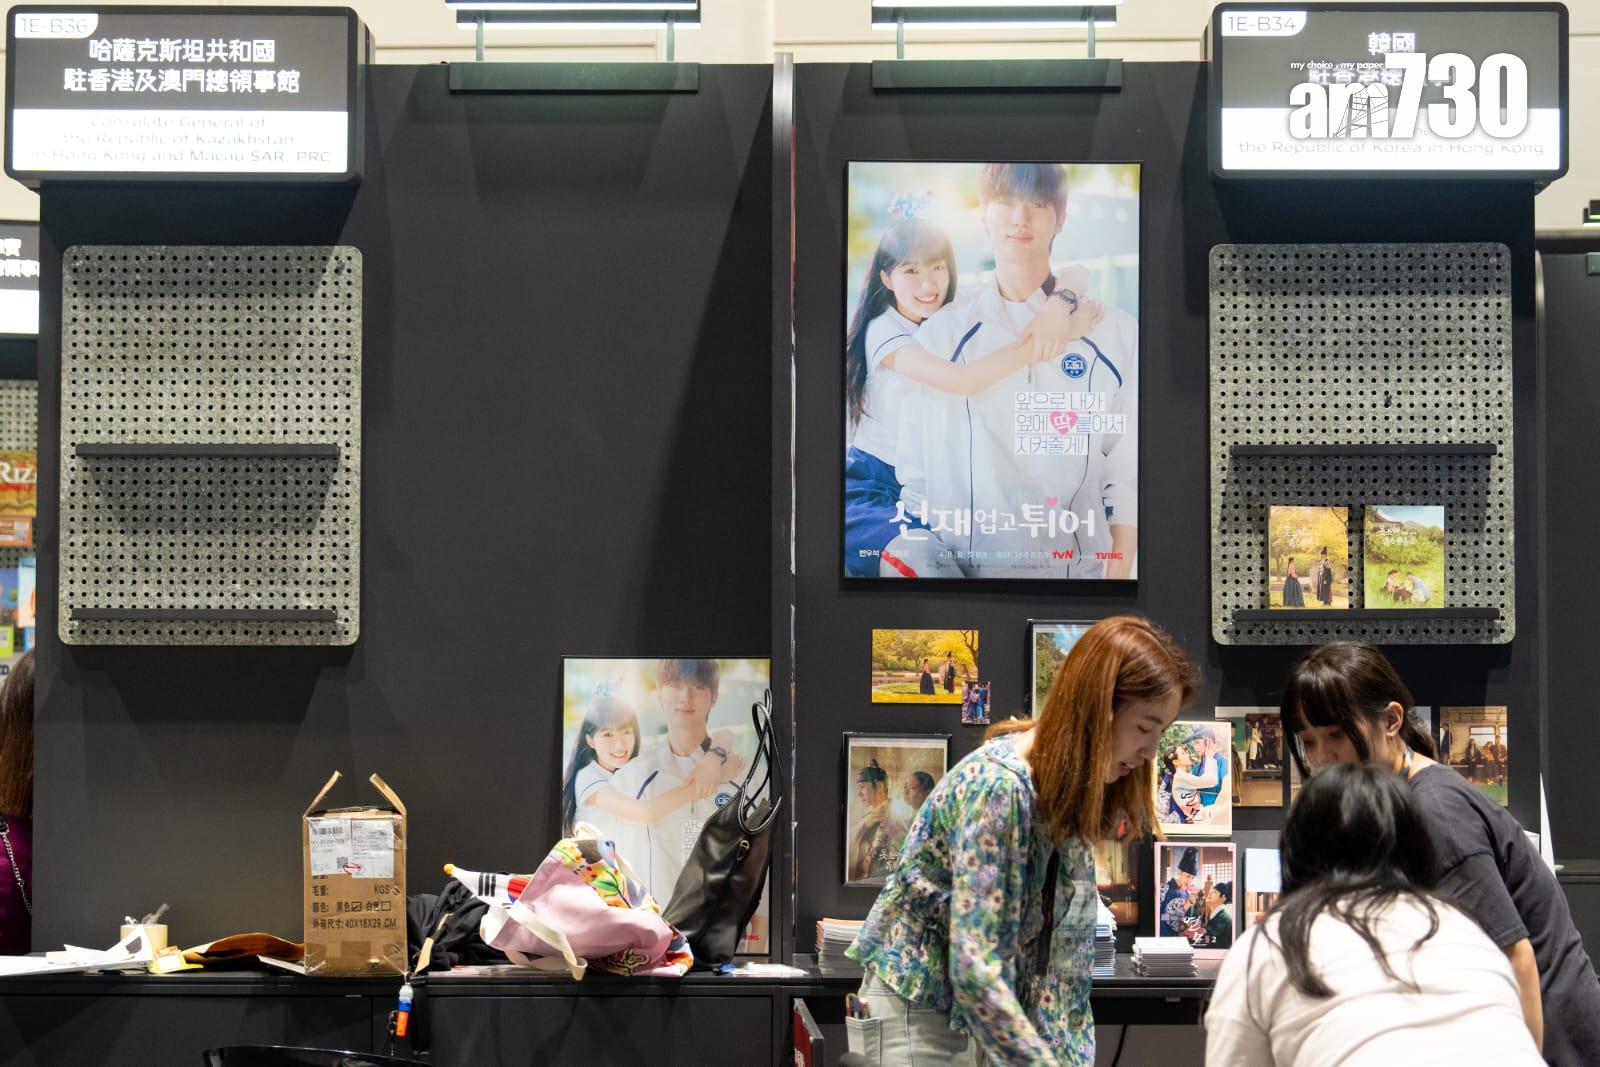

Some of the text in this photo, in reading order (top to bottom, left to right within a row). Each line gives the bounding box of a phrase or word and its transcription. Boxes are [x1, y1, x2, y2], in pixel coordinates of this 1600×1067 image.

[20, 17, 88, 34] 1E-B36
[1227, 16, 1296, 32] 1E-B34
[89, 38, 276, 63] 哈薩克斯坦共和國
[1367, 31, 1416, 54] 韓國
[63, 68, 301, 94] 駐香港及澳門總領事館
[250, 116, 267, 128] of
[96, 133, 168, 147] Republic
[172, 133, 190, 145] of
[195, 133, 295, 145] Kazakhstan
[1239, 141, 1544, 156] the Republic of Korea in Hong Kong
[102, 150, 146, 164] Kong
[151, 150, 183, 161] and
[296, 151, 331, 162] PRC
[1016, 392, 1104, 410] 앞으로 내가
[1016, 413, 1124, 434] 옆에 딱 붙어서
[1016, 436, 1085, 454] 지켜줄게!
[1051, 549, 1074, 560] tvN
[1095, 552, 1124, 560] TVING
[374, 884, 391, 895] KGS
